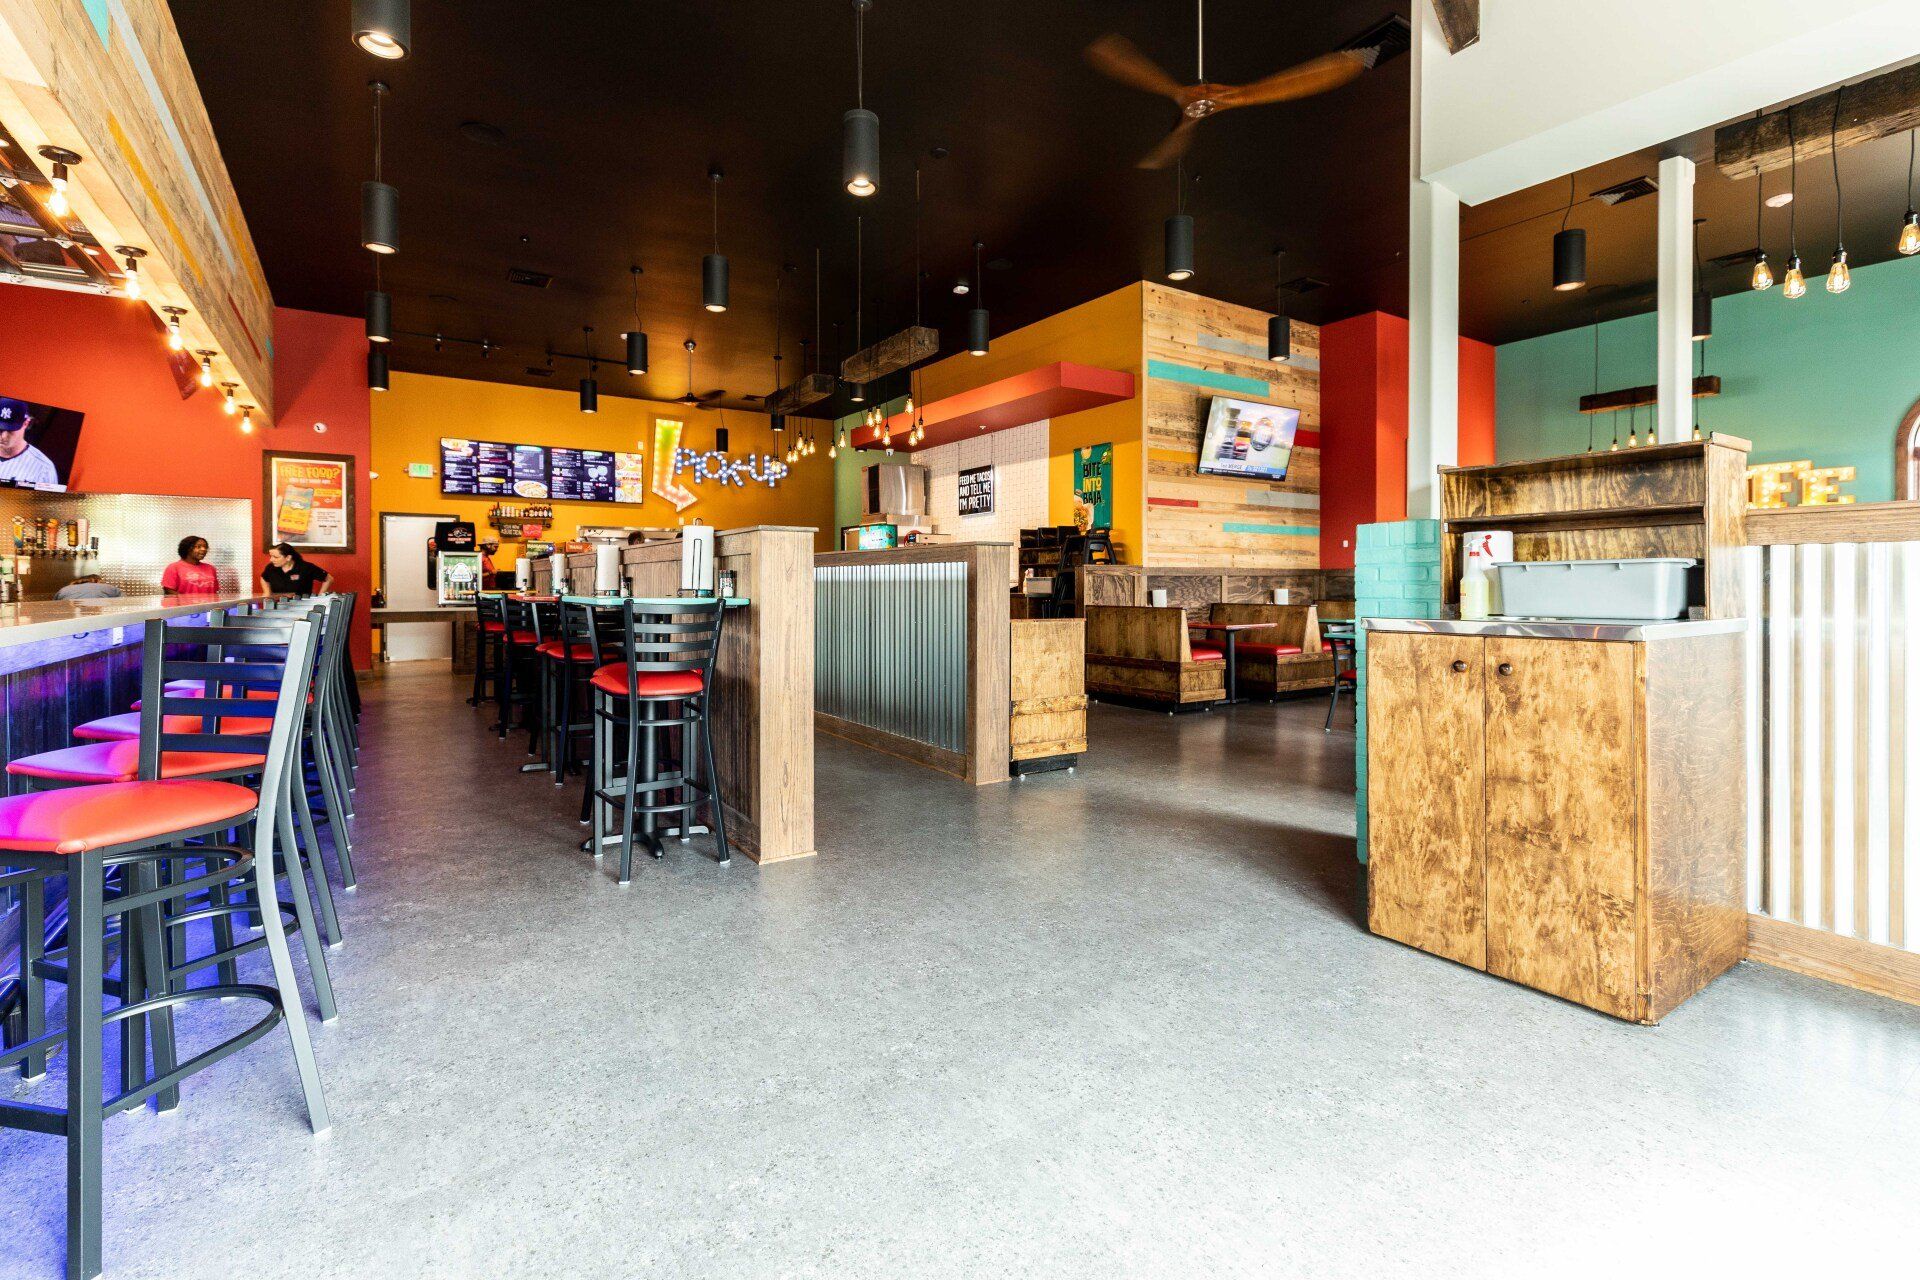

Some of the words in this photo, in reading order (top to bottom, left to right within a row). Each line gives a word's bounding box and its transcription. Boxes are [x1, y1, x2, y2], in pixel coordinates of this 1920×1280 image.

[280, 464, 303, 478] FREE
[306, 466, 340, 480] FOOD?
[675, 447, 788, 488] PICK-UP
[1083, 461, 1102, 478] BITE
[959, 474, 970, 486] FEED
[970, 473, 977, 484] ME
[977, 470, 991, 483] TACOS
[1083, 477, 1102, 493] INTO
[960, 485, 970, 497] AND
[970, 483, 983, 496] TELL
[983, 481, 991, 493] ME
[960, 497, 968, 511] I'M
[969, 493, 991, 510] PRETTY
[1083, 491, 1102, 506] BAJA
